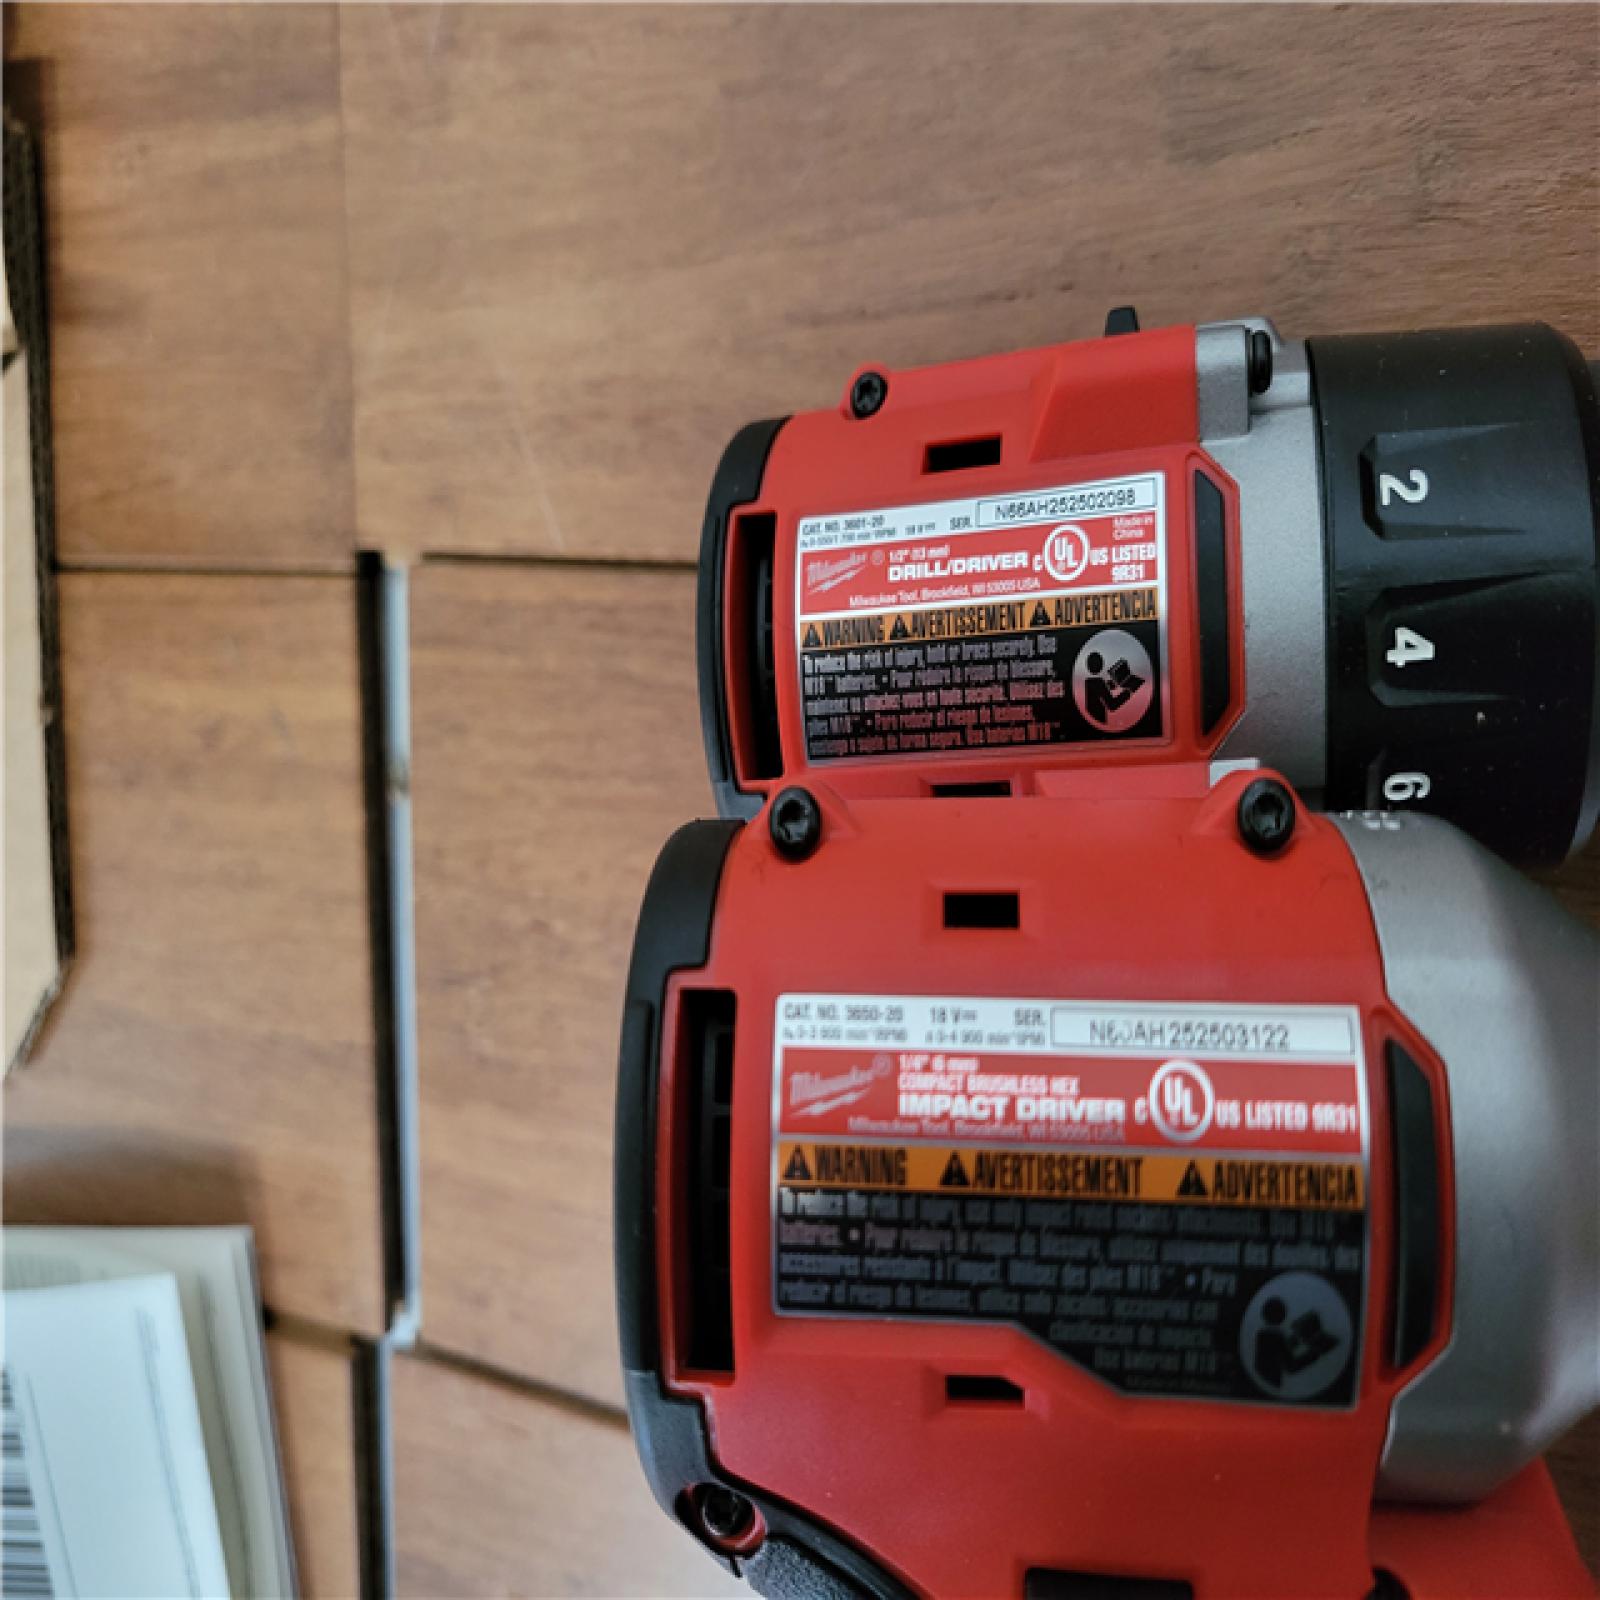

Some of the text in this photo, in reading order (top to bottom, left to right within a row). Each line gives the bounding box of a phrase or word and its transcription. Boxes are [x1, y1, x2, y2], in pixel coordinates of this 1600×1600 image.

[1379, 469, 1429, 506] 2
[888, 551, 1028, 582] DRILL/DRIVER
[1090, 547, 1108, 565] US
[1112, 542, 1156, 563] LISTED
[822, 587, 1156, 647] WARNING AVERTISSEMENT ADVERTENCIA
[1386, 627, 1436, 668] 4
[1384, 771, 1431, 801] 6
[898, 1072, 965, 1092] COMPACT
[899, 1095, 1126, 1124] IMPACT DRIVER
[1215, 1100, 1242, 1130] US
[1245, 1102, 1308, 1132] LISTED
[814, 1145, 1358, 1204] WARNING AVERTISSEMENT ADVERTENCIA
